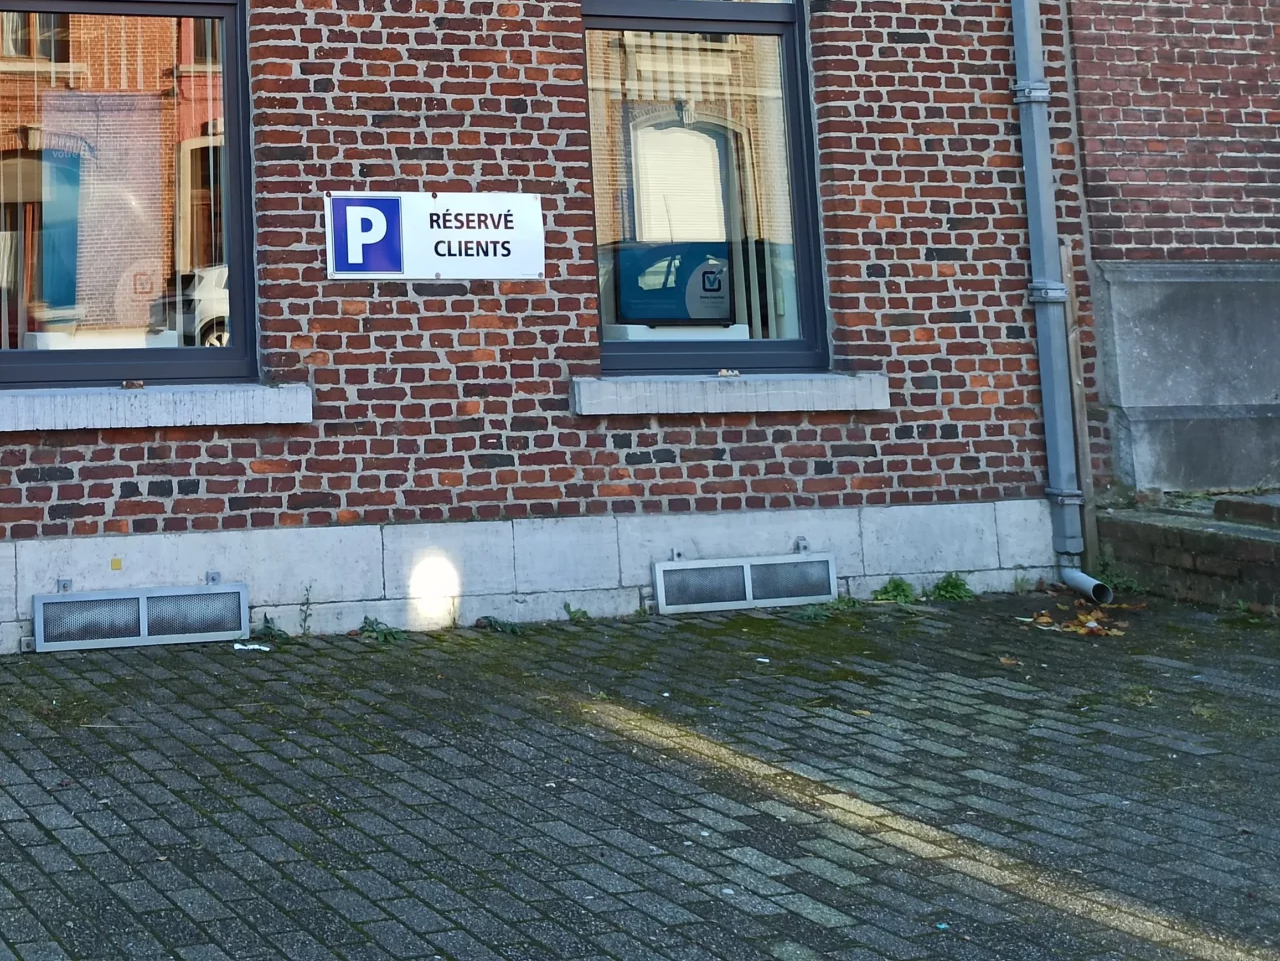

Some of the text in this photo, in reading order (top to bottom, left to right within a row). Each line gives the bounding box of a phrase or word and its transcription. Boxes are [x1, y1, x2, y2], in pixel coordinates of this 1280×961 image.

[429, 208, 514, 229] RÉSERVÉ
[346, 206, 387, 264] P
[434, 240, 511, 257] CLIENTS
